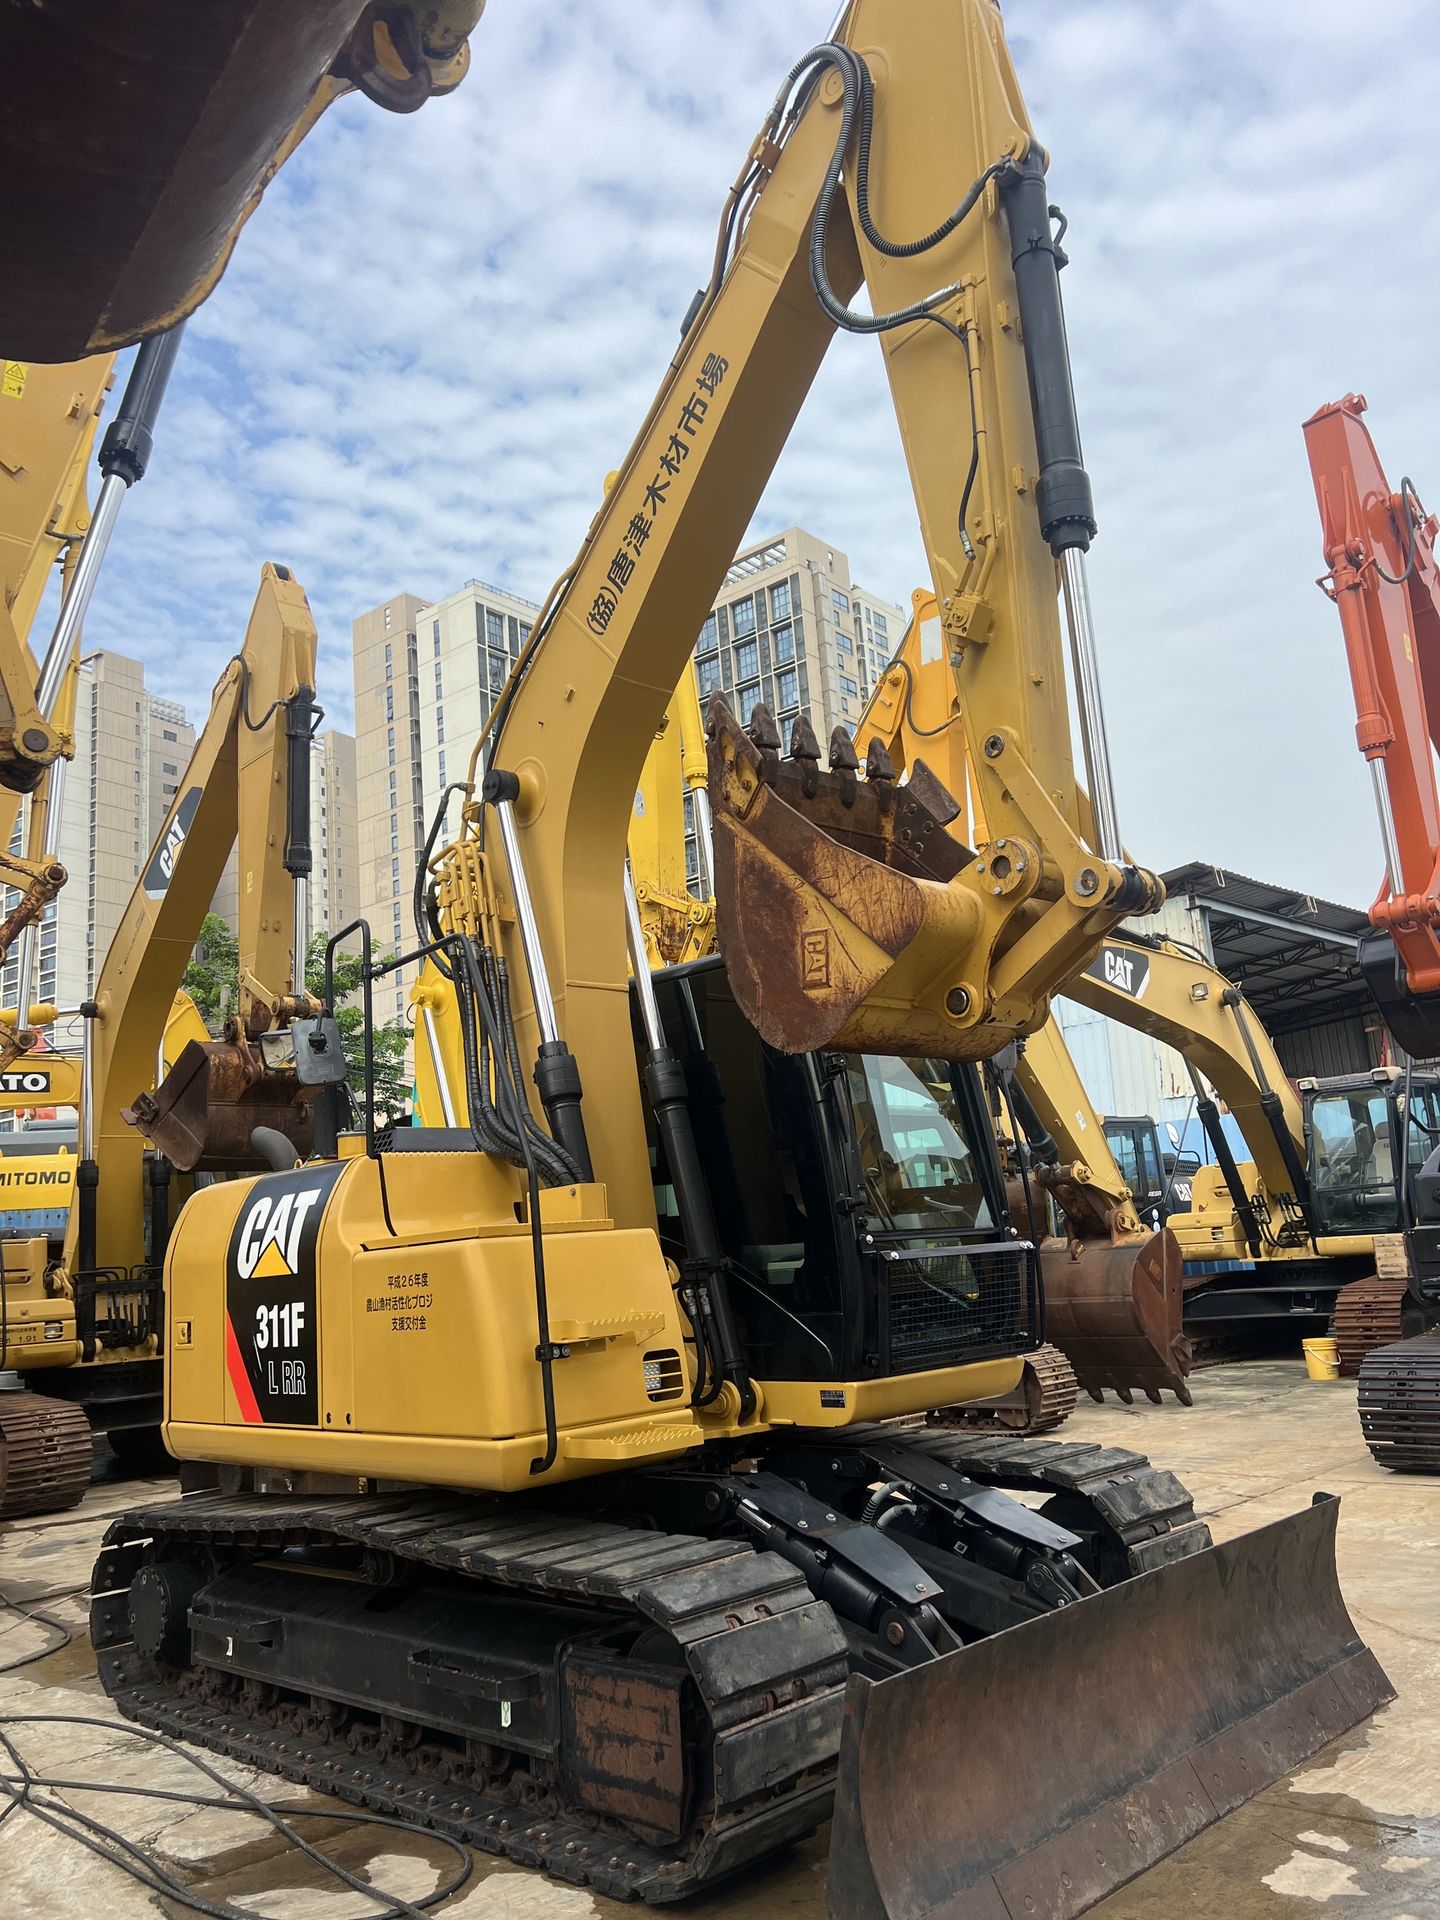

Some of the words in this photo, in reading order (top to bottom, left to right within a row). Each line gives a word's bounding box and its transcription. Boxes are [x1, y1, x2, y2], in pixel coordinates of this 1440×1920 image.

[587, 352, 729, 635] (協)唐津木材市場
[160, 814, 185, 879] CAT
[804, 934, 827, 983] CAT
[1105, 950, 1134, 992] CAT
[237, 1189, 322, 1280] CAT
[387, 1273, 429, 1289] 平成26年度
[256, 1302, 305, 1349] 311F
[391, 1315, 427, 1331] 支援交付金
[268, 1360, 279, 1395] L
[282, 1360, 307, 1395] RR
